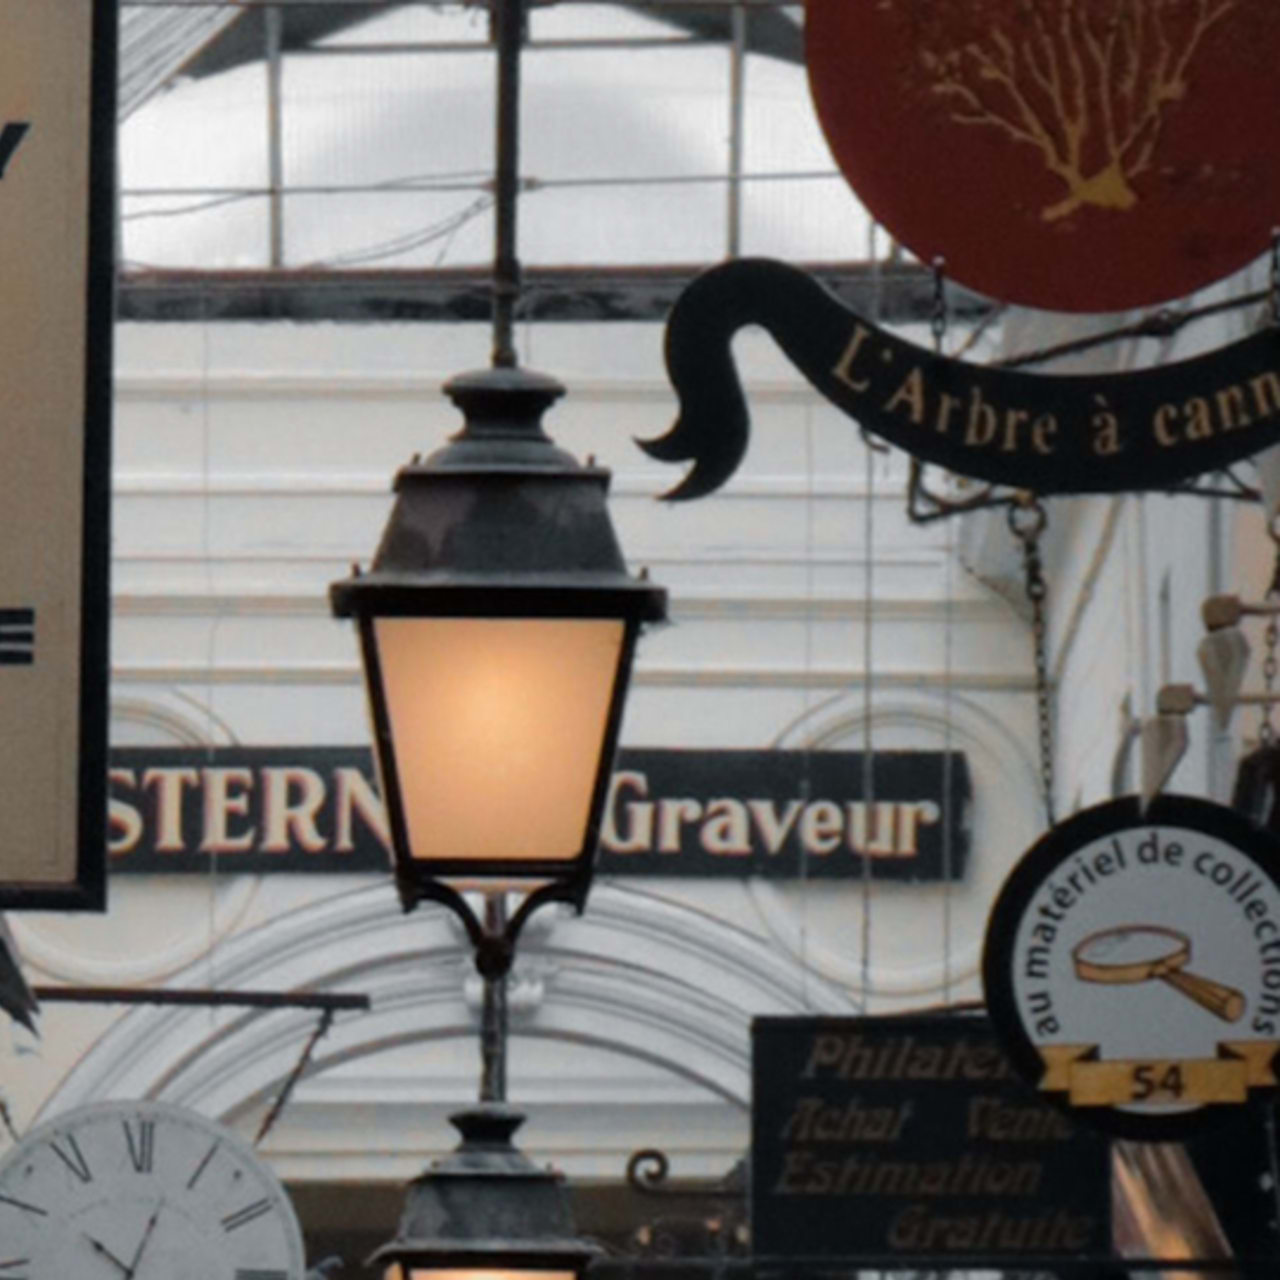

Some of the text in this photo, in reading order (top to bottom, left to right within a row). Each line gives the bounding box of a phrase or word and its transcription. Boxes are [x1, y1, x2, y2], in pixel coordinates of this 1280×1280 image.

[830, 323, 1058, 455] L'Arbre
[1092, 392, 1120, 456] à
[598, 769, 941, 860] Graveur
[1027, 992, 1060, 1036] au
[1137, 831, 1184, 867] de
[773, 1150, 1044, 1196] Estimation
[884, 1202, 1097, 1251] Gratuite
